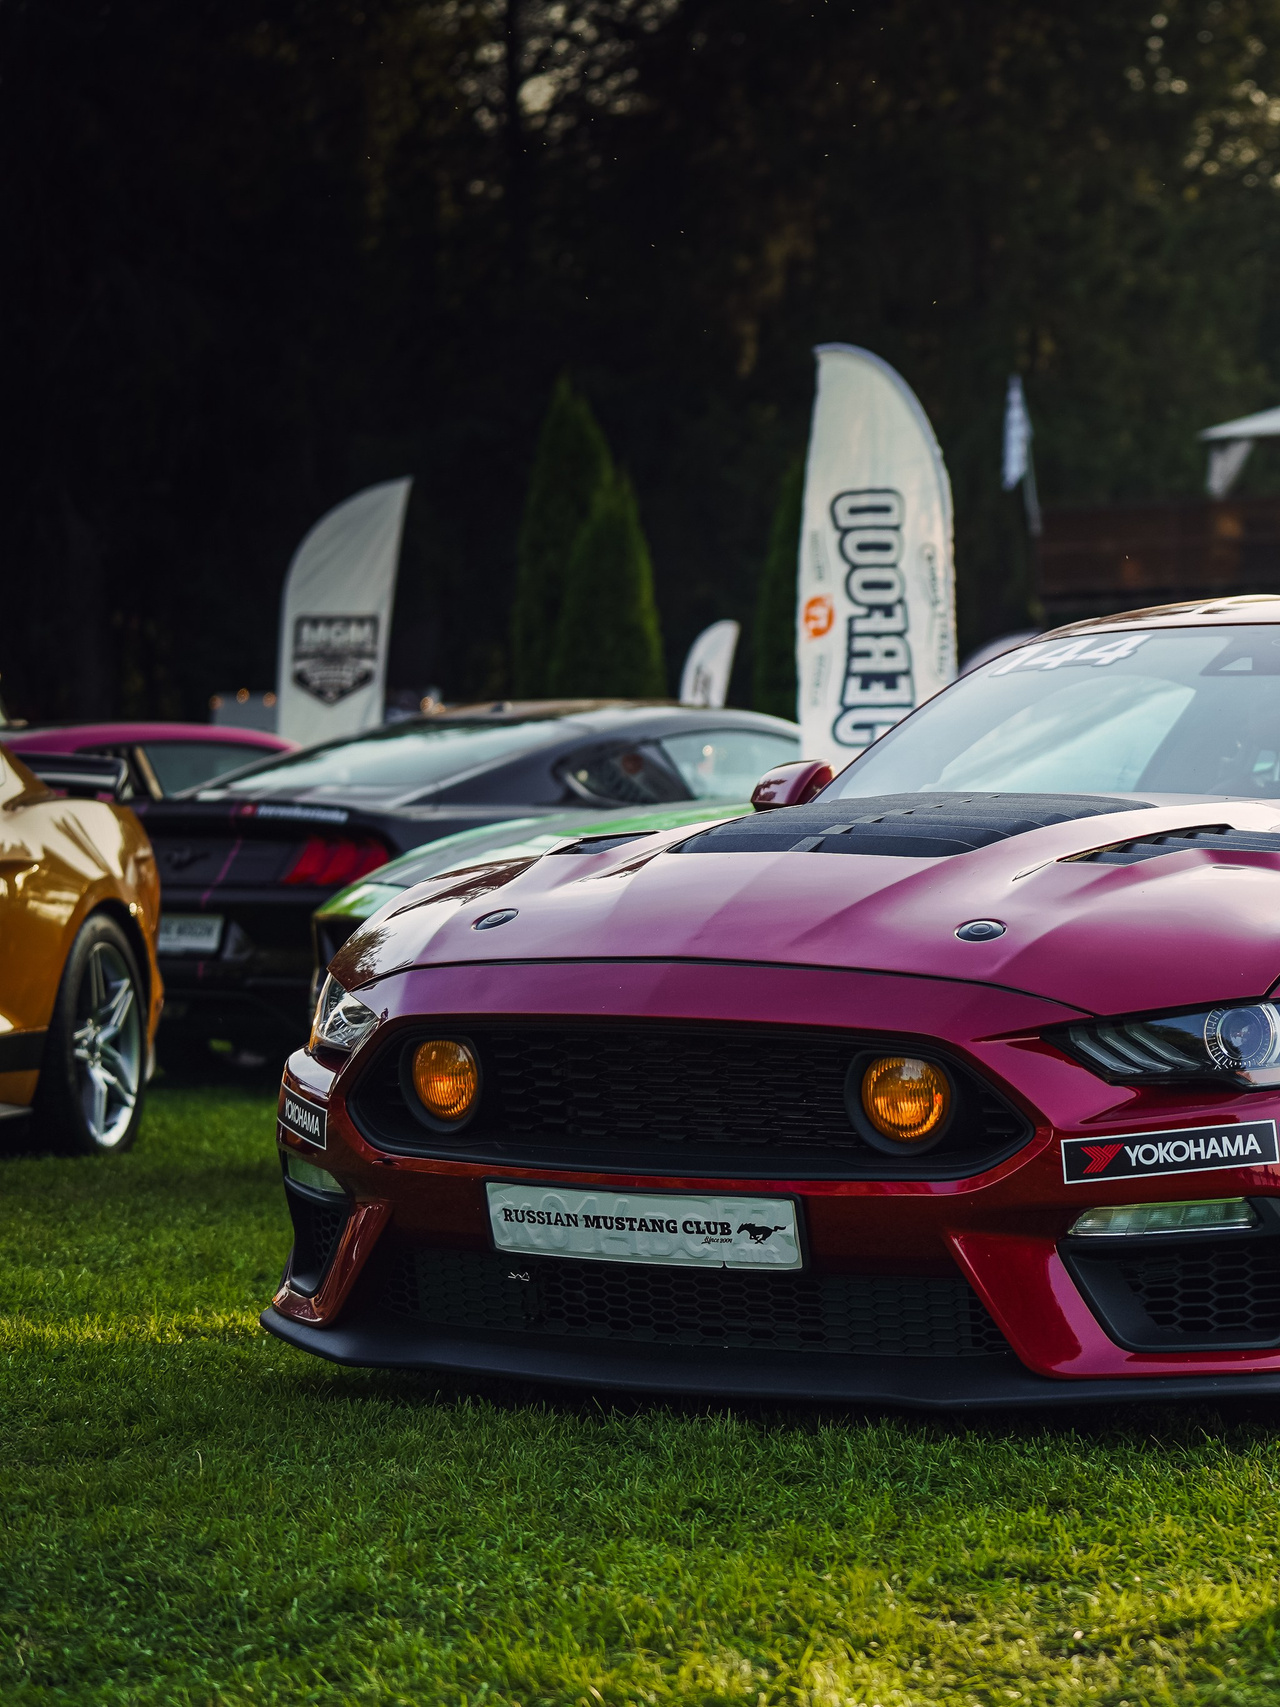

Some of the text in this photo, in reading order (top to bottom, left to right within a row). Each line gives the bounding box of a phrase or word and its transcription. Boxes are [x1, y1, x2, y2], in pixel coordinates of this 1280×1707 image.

[988, 634, 1153, 677] 144
[285, 1098, 321, 1137] YOKOHAMA
[1125, 1133, 1262, 1167] YOKOHAMA
[502, 1208, 579, 1228] RUSSIAN
[583, 1215, 678, 1234] MUSTANG
[682, 1220, 733, 1236] CLUB
